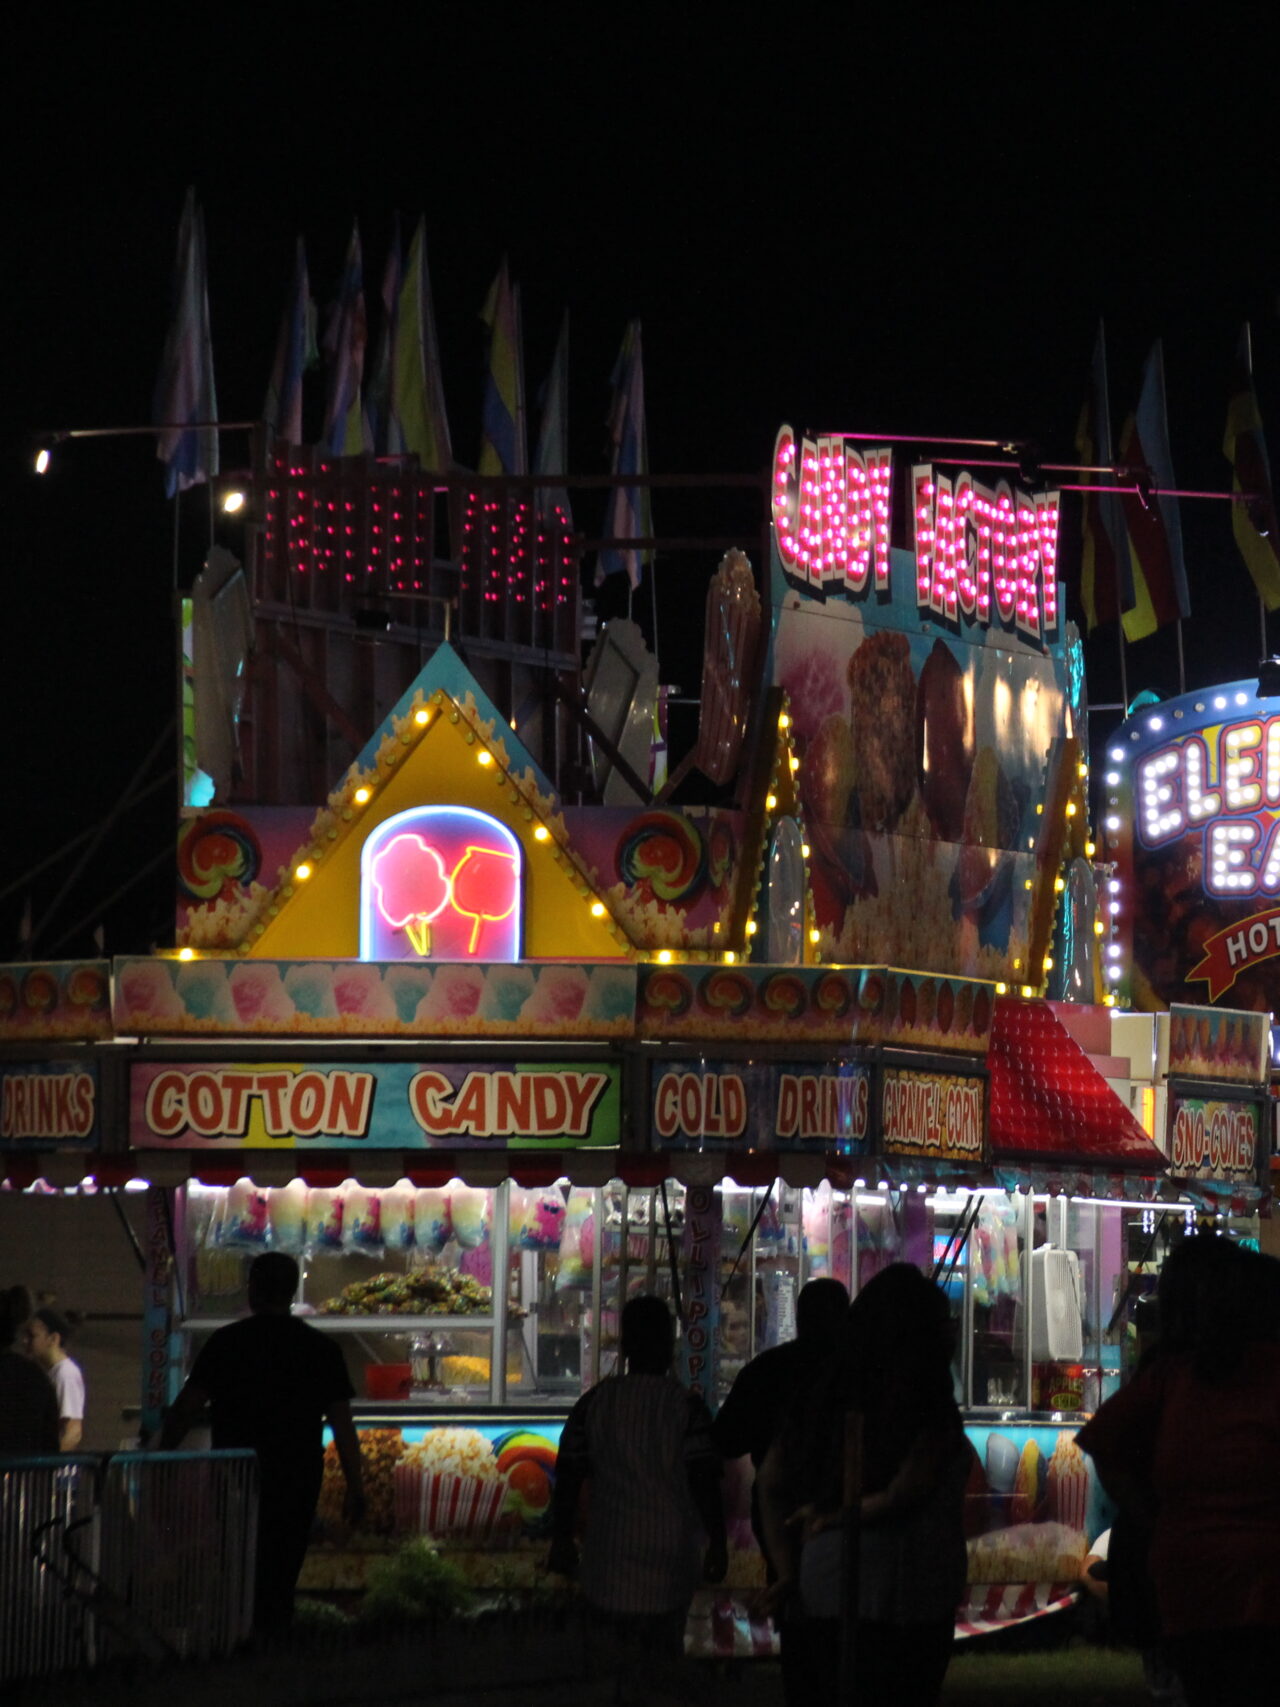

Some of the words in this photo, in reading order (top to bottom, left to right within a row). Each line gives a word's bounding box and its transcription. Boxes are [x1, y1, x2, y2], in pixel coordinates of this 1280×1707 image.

[772, 425, 893, 591] CANDY
[912, 463, 1061, 641] FACTORY
[145, 1070, 376, 1138] COTTON
[408, 1071, 609, 1138] CANDY
[653, 1072, 747, 1138] COLD
[775, 1074, 869, 1140] DRINKS
[882, 1077, 942, 1148] CARAMEL
[945, 1085, 981, 1150] CORN
[1173, 1107, 1256, 1171] SNO-CONES
